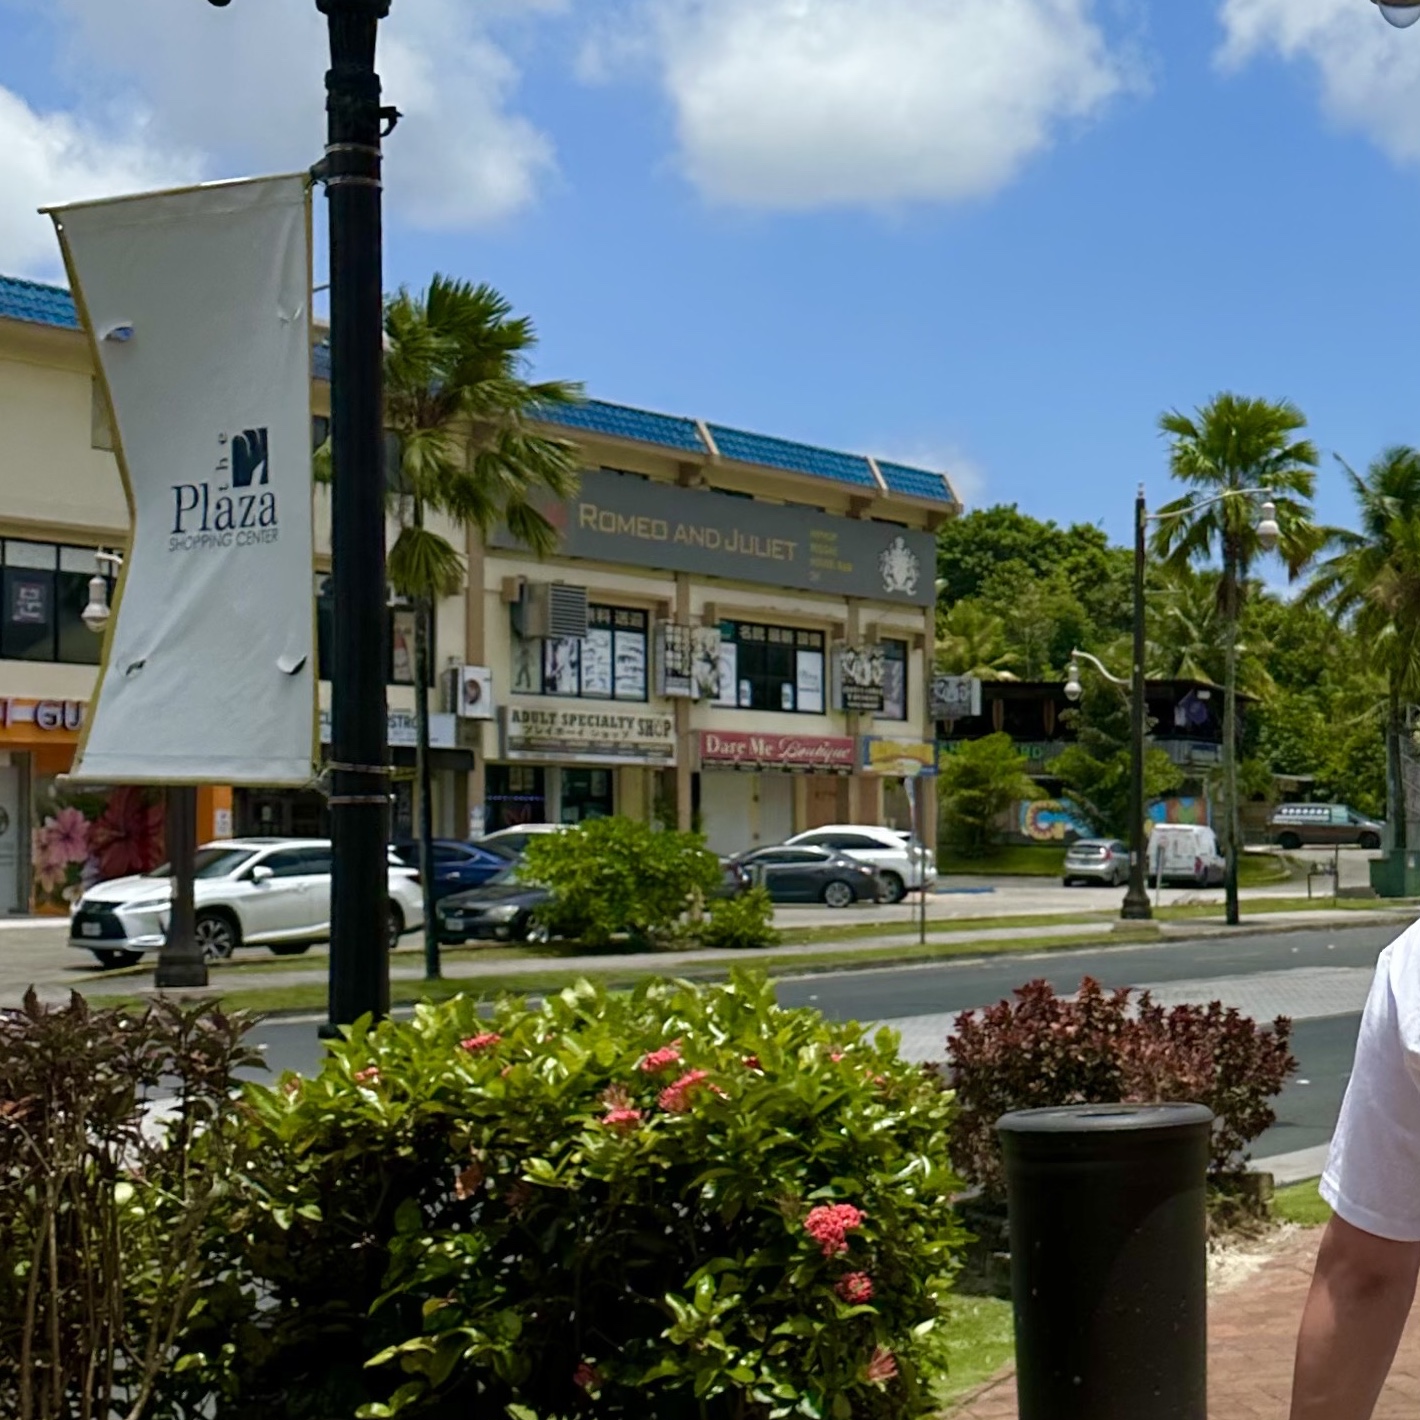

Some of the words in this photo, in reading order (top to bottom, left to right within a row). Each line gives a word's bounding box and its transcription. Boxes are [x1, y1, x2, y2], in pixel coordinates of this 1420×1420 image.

[170, 483, 277, 534] Plaza
[169, 533, 232, 552] SHOPPING
[236, 528, 278, 547] CENTER
[579, 503, 667, 540] ROMEO
[725, 529, 797, 561] JULIET
[512, 710, 557, 726] ADULT
[562, 713, 635, 729] SPECIALTY
[637, 718, 672, 738] SHOP
[706, 734, 746, 755] Dare
[750, 736, 773, 757] Me
[778, 738, 851, 763] Boutique
